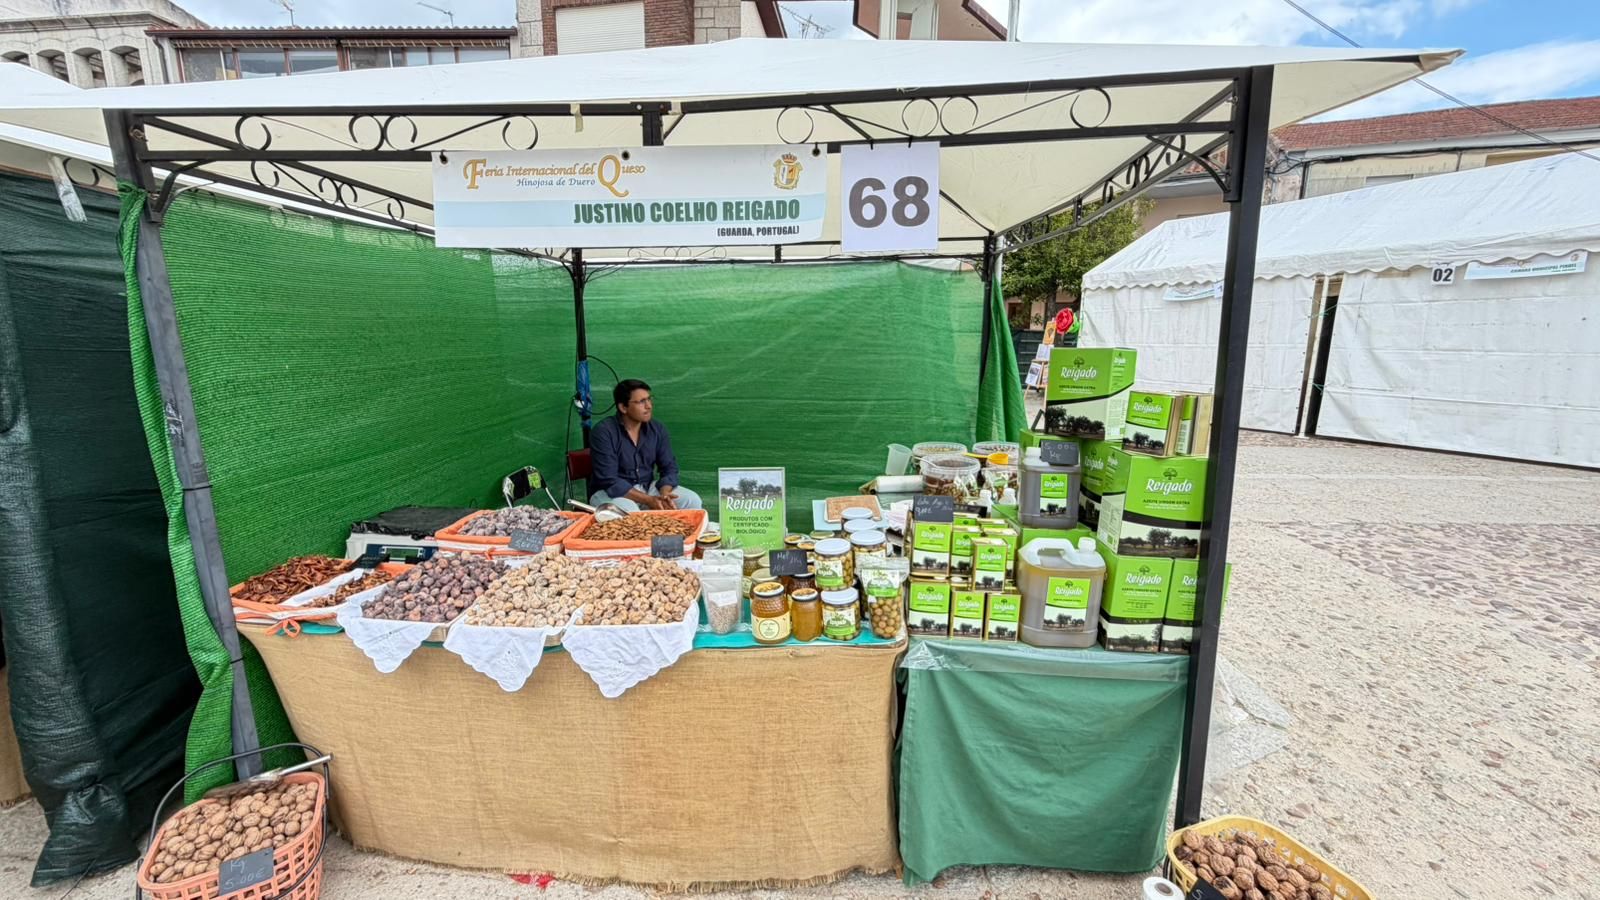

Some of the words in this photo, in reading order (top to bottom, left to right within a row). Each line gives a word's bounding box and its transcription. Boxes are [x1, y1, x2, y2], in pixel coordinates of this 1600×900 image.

[463, 159, 504, 189] Feria
[506, 163, 579, 176] Internacional
[579, 163, 597, 176] del
[597, 154, 646, 197] Queso
[516, 178, 554, 188] Hinojosa
[556, 178, 566, 186] de
[569, 178, 596, 186] Duero
[849, 176, 930, 228] 68
[573, 203, 645, 224] JUSTINO
[650, 201, 717, 223] COELHO
[723, 199, 801, 221] REIGADO
[717, 226, 754, 237] (GUARDA,
[756, 225, 800, 236] PORTUGAL)
[1433, 268, 1453, 282] 02
[1060, 366, 1097, 381] Reigado
[1146, 478, 1193, 495] Reigado
[726, 495, 774, 514] Reigado
[1126, 573, 1162, 586] Reigado
